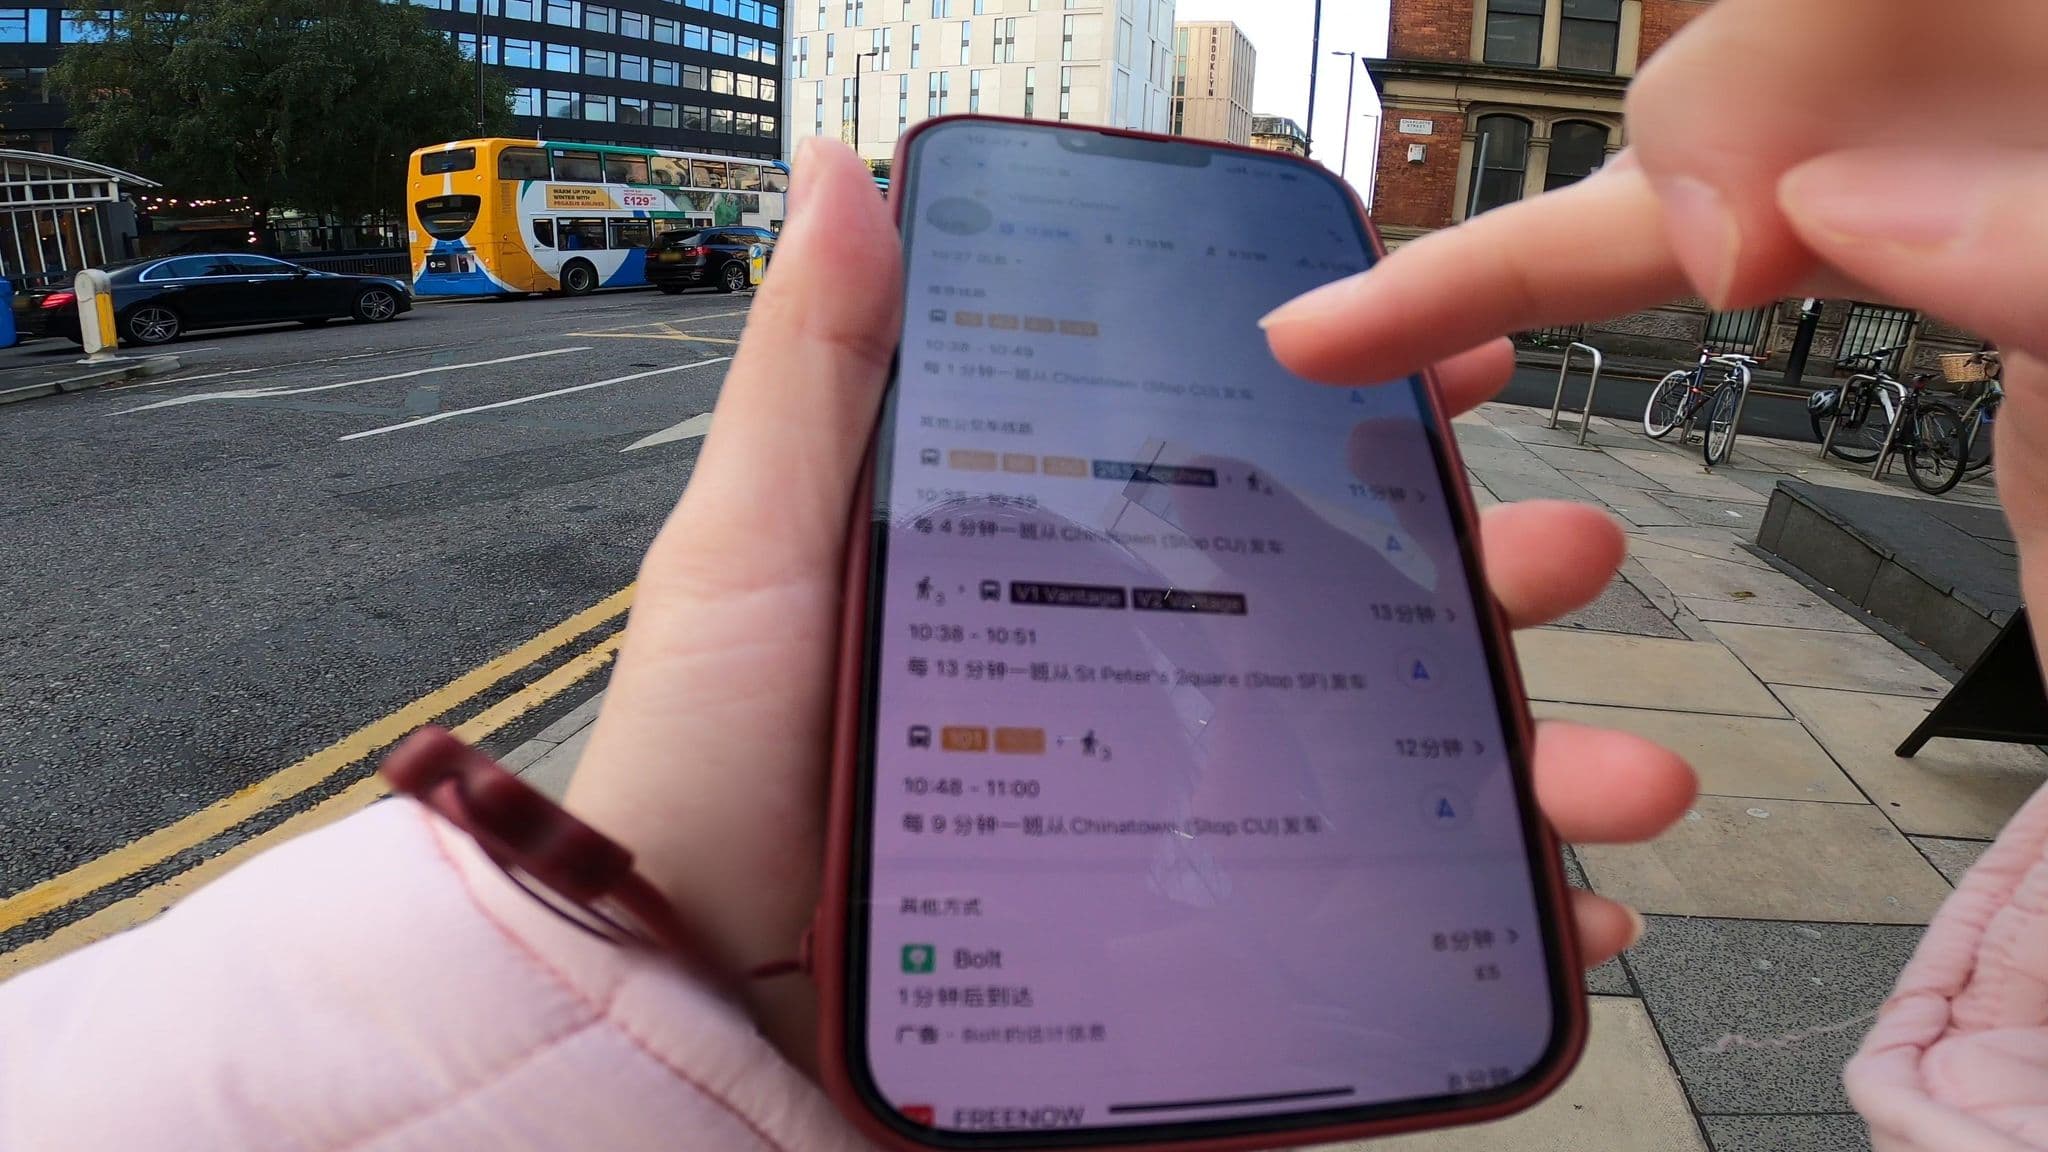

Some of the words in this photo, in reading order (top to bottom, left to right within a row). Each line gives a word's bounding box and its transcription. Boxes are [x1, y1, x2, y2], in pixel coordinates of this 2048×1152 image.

[1208, 27, 1217, 97] BROOKLYN
[624, 196, 650, 205] £129
[909, 624, 964, 643] 10:38
[986, 626, 1037, 646] 10:51
[904, 777, 963, 797] 10:48
[986, 779, 1039, 798] 11:00
[931, 816, 947, 835] 9
[954, 948, 1003, 970] Bolt
[896, 1024, 938, 1045] 广告
